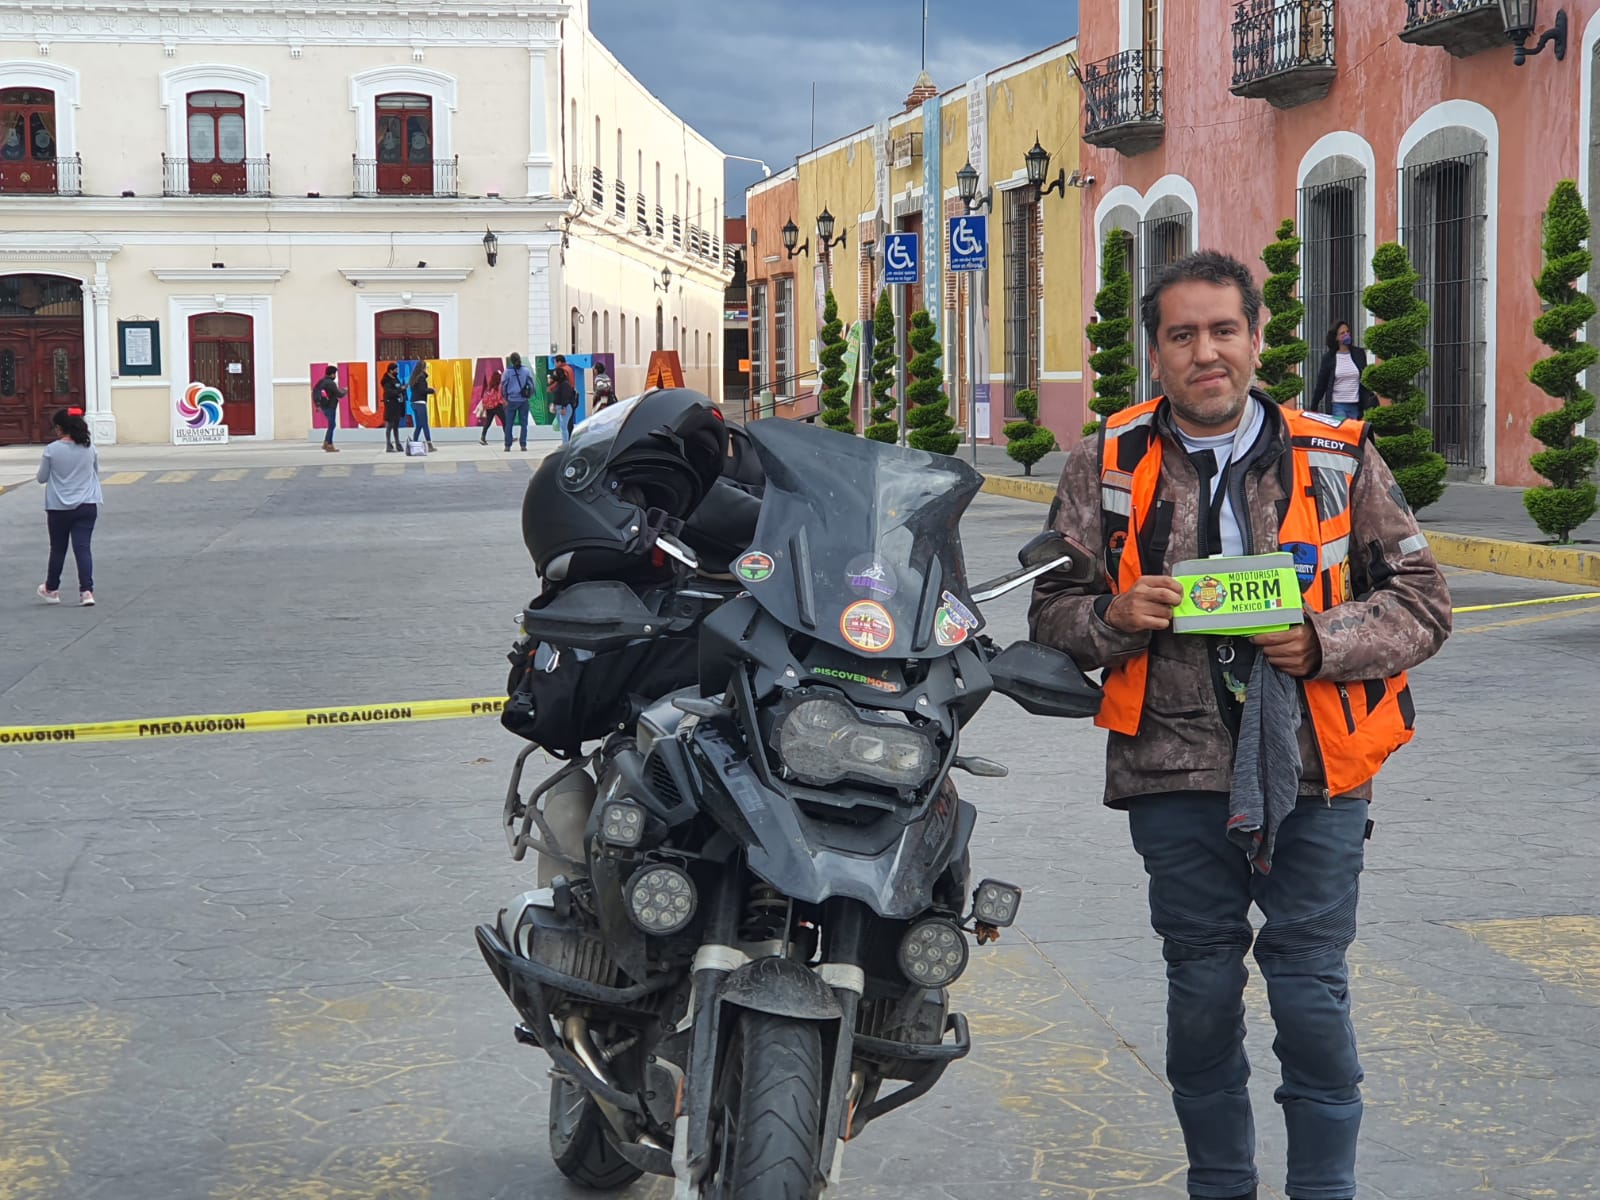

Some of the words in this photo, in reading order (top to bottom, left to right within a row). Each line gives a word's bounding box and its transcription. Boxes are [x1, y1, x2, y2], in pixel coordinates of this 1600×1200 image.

[1311, 438, 1344, 450] FREDY
[1229, 569, 1279, 581] MOTOTURISTA
[1230, 579, 1281, 602] RRM
[813, 667, 897, 693] DISCOVERMOTO
[306, 708, 412, 725] PRECAUCION
